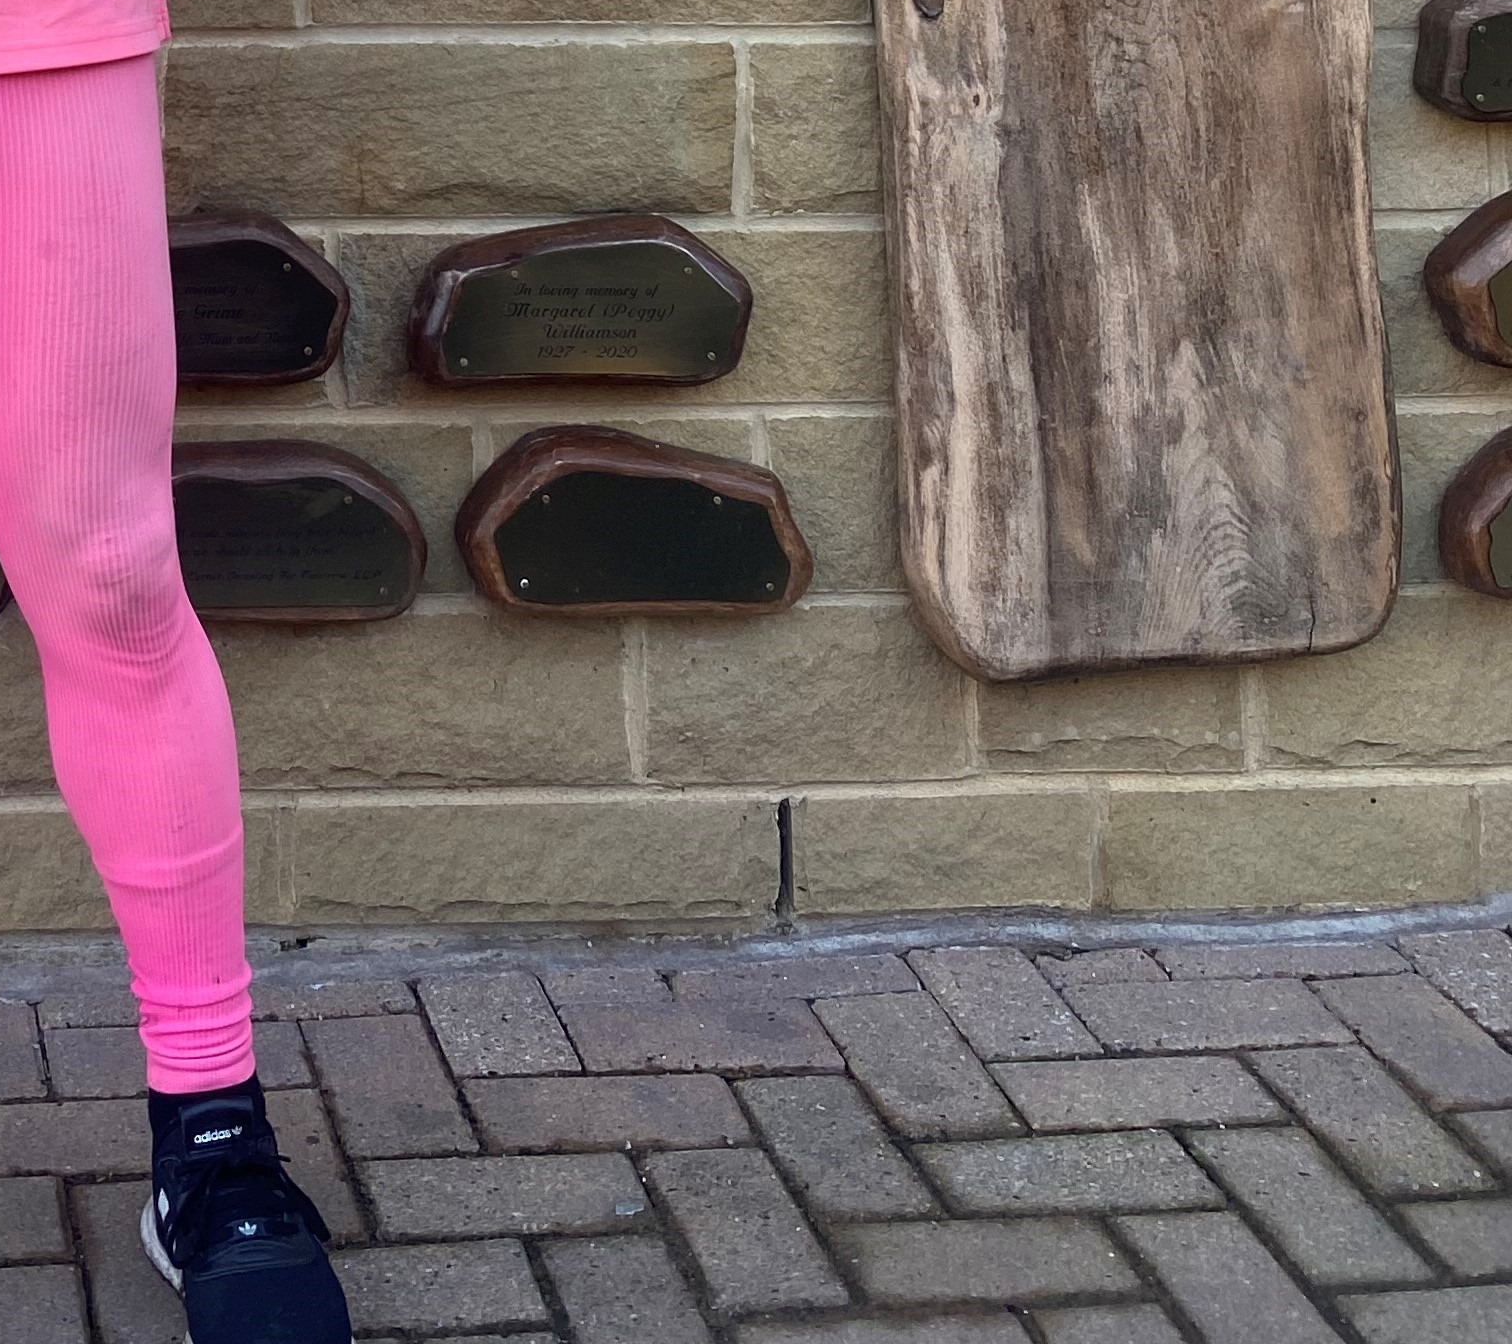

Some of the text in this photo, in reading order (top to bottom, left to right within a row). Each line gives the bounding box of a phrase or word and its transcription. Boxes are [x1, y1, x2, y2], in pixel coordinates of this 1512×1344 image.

[514, 282, 659, 299] In loving memory of
[503, 302, 675, 321] Margaret (Peggy)
[542, 323, 637, 340] Williamson
[538, 345, 575, 358] 1927
[596, 345, 638, 359] 2020
[194, 1129, 231, 1144] adidas
